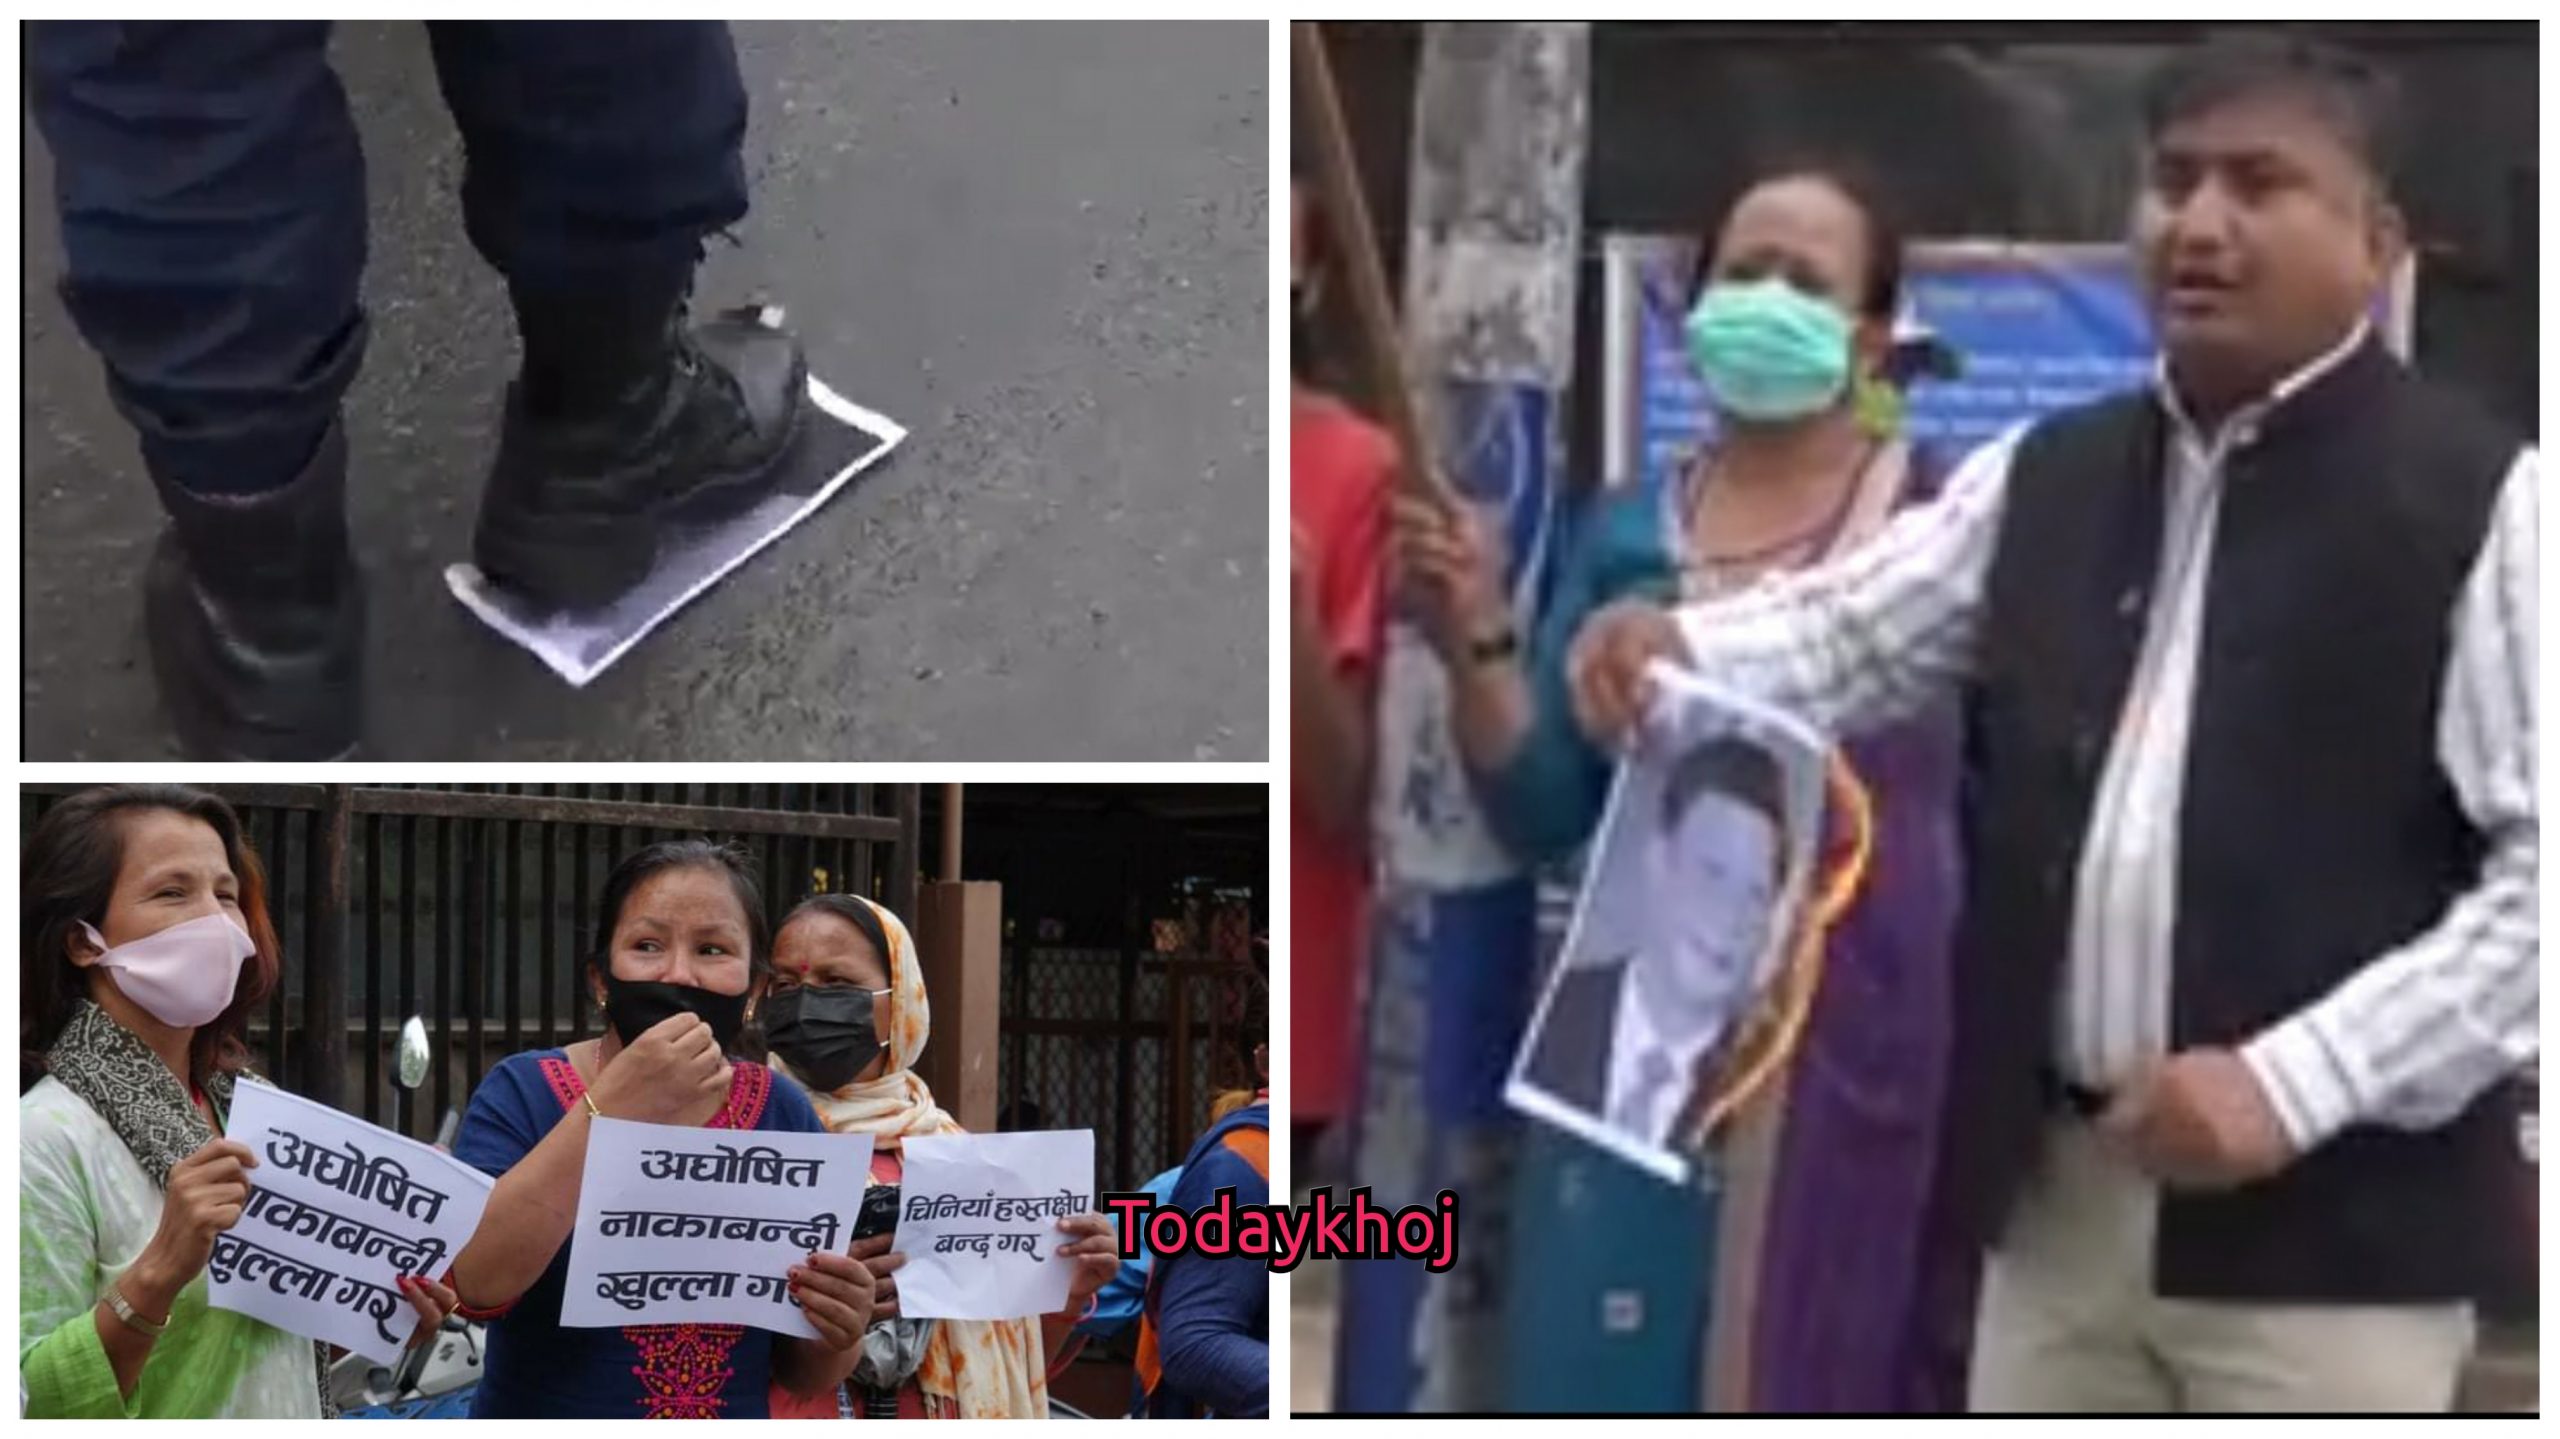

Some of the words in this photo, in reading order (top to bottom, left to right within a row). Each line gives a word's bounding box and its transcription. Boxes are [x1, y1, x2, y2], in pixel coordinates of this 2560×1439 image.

[265, 1126, 450, 1225] अघोषित
[641, 1144, 825, 1188] अघोषित
[904, 1189, 995, 1222] चिनियाँ
[994, 1188, 1088, 1222] हस्तक्षेप
[241, 1184, 448, 1277] ाकाबन्दी
[600, 1211, 840, 1255] नाकाबन्दी
[934, 1233, 994, 1259] बन्द
[996, 1234, 1045, 1262] गर
[335, 1276, 406, 1345] गर
[596, 1271, 741, 1311] खुल्ला
